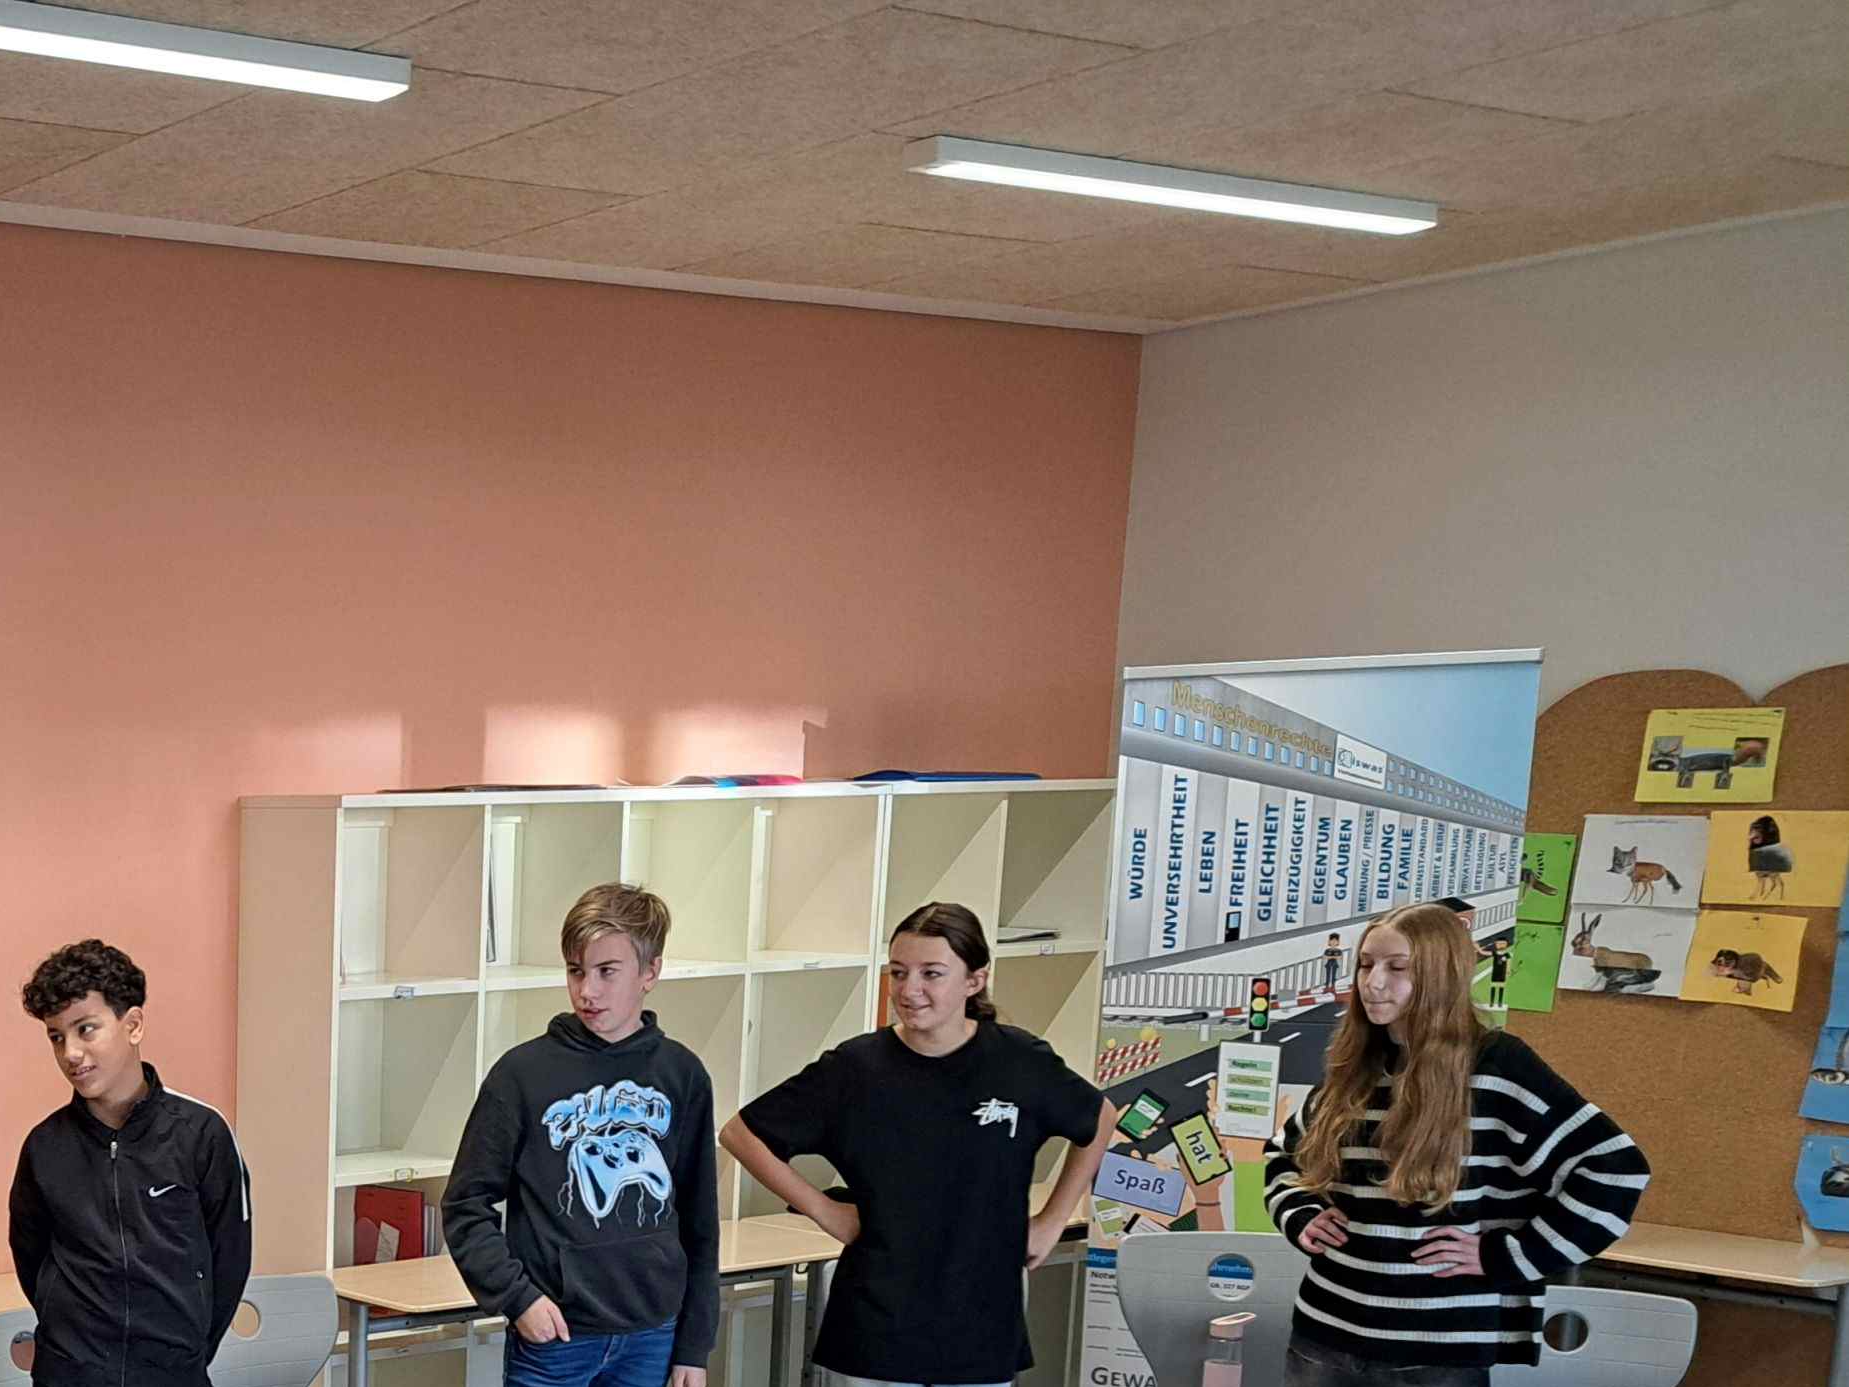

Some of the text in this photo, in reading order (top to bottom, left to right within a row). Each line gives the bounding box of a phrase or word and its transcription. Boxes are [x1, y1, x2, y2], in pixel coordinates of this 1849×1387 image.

[1172, 679, 1333, 757] Menschenrechte
[1162, 774, 1189, 949] UNVERSEHRTHEIT
[1285, 797, 1307, 924] FREIZÜGIGKEIT
[1312, 816, 1331, 905] EIGENTUM
[1334, 818, 1353, 901] GLAUBEN
[1362, 809, 1375, 850] PRESSE
[1376, 823, 1396, 900] BILDUNG
[1397, 828, 1414, 891] FAMILIE
[1414, 818, 1429, 903] LEBENSSTANDARD
[1435, 822, 1445, 853] BERUF
[1447, 827, 1460, 895] VERSAMMLUNG
[1473, 832, 1486, 889] BETEILIGUNG
[1486, 843, 1496, 879] KULTUR
[1498, 850, 1507, 872] ASYL
[1507, 836, 1519, 885] PFLICHTEN
[1127, 827, 1148, 901] WÜRDE
[1198, 830, 1217, 894] LEBEN
[1229, 818, 1250, 907] FREIHEIT
[1257, 803, 1280, 922] GLEICHHEIT
[1358, 858, 1371, 912] MEINUNG
[1430, 863, 1441, 898] ARBEIT
[1185, 1130, 1212, 1164] hat
[1114, 1168, 1166, 1195] Spaß
